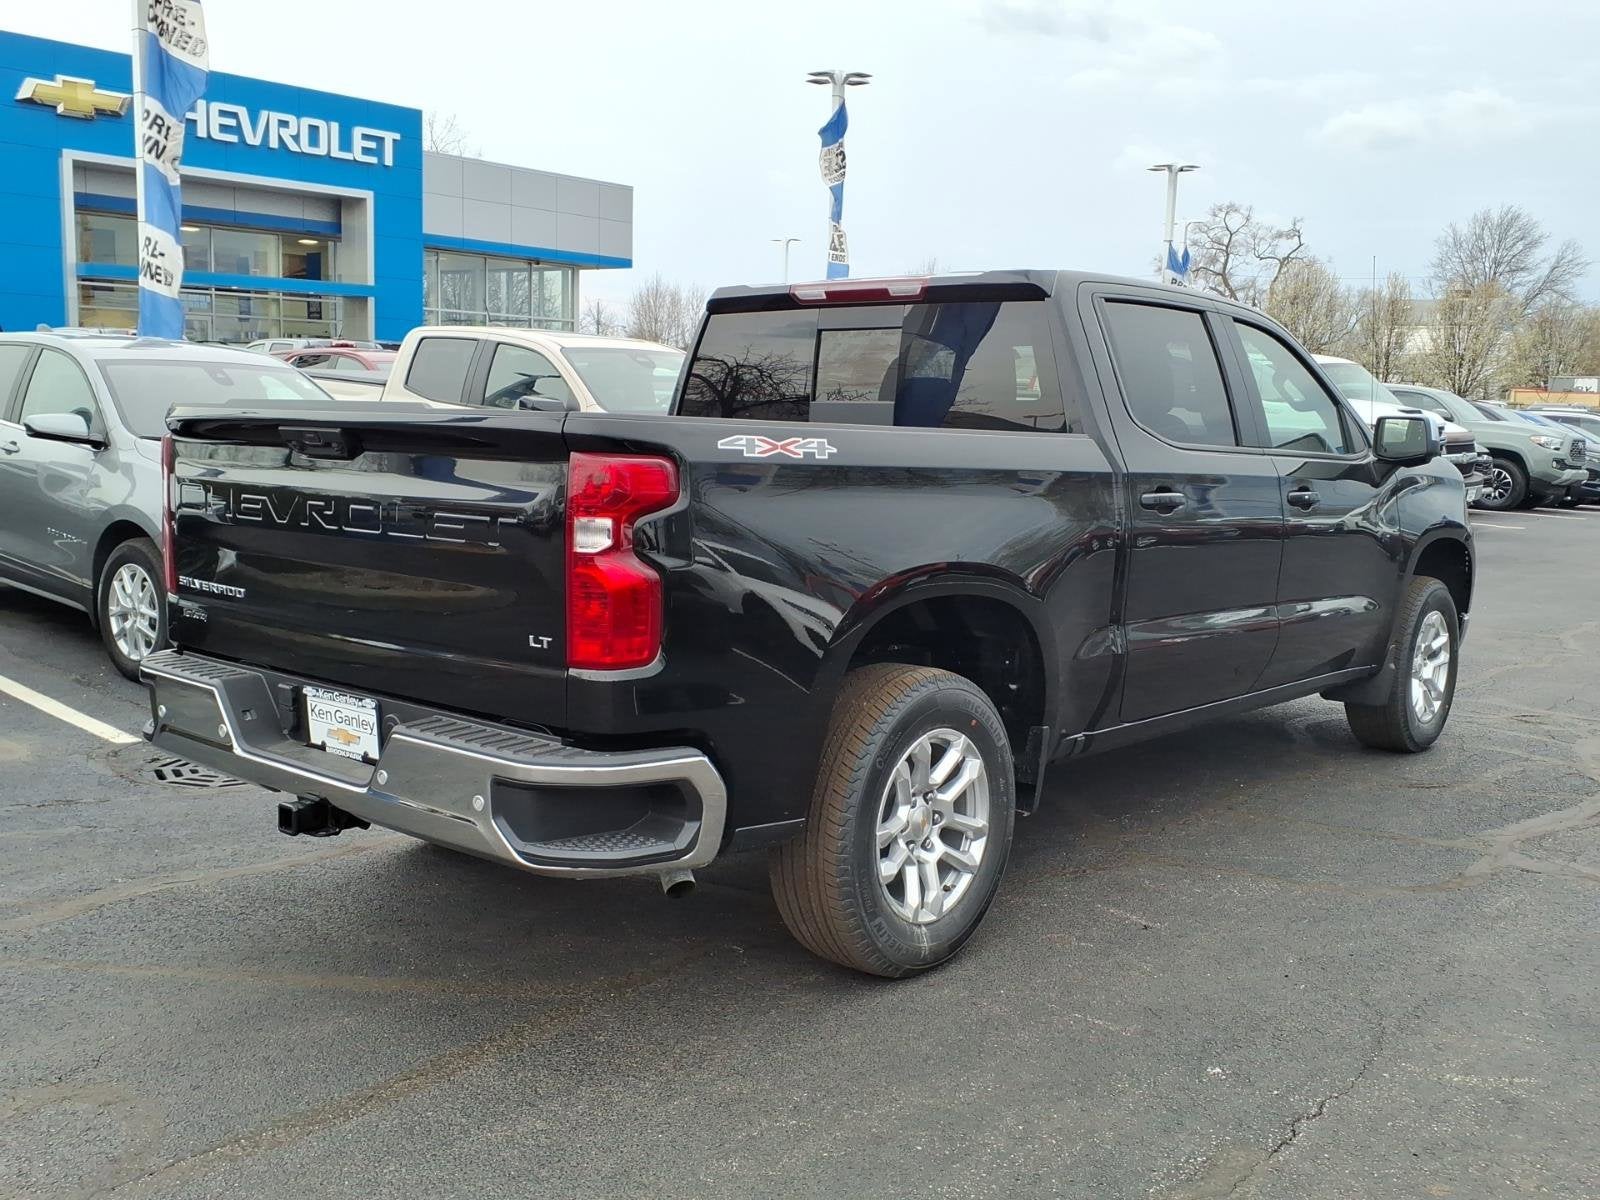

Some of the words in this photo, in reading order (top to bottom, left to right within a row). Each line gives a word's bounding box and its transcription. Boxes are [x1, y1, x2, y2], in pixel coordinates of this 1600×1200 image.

[185, 99, 400, 167] HEVROLET
[178, 483, 523, 547] CHEVROLET
[178, 575, 246, 598] SILVERADO
[528, 635, 553, 649] LT
[310, 702, 333, 721] Ken
[333, 709, 376, 736] Ganley
